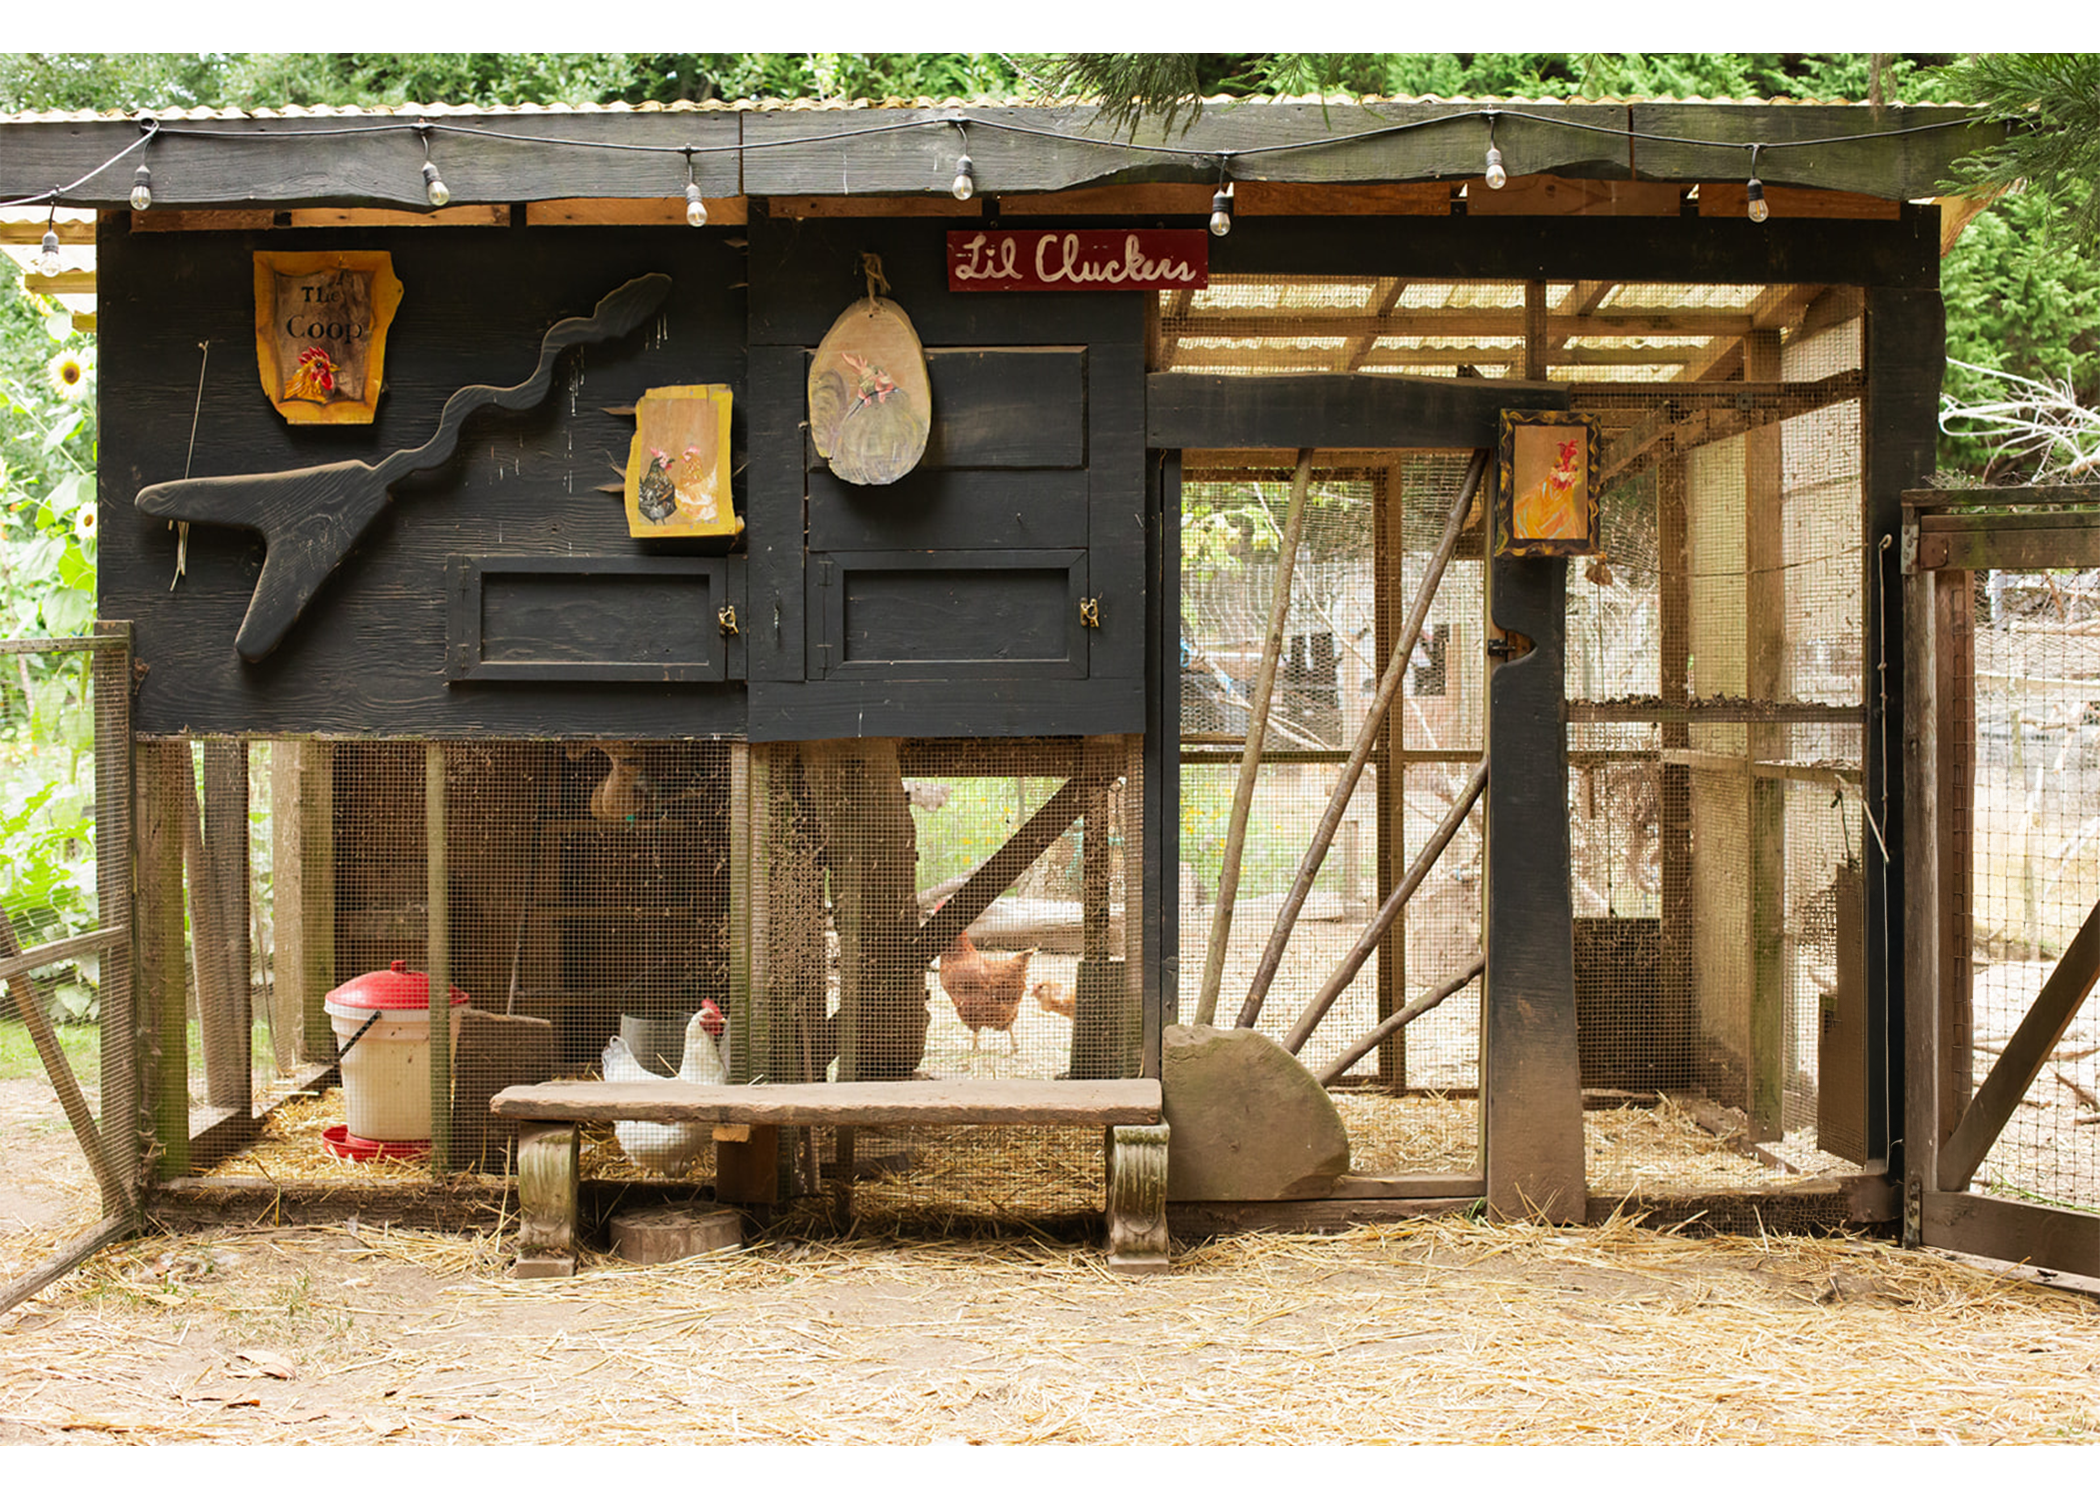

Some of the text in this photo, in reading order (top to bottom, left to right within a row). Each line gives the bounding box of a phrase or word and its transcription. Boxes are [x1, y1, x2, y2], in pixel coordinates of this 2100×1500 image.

[955, 233, 1196, 283] Lil Cluckers
[301, 286, 340, 303] The
[286, 315, 362, 344] Coop
